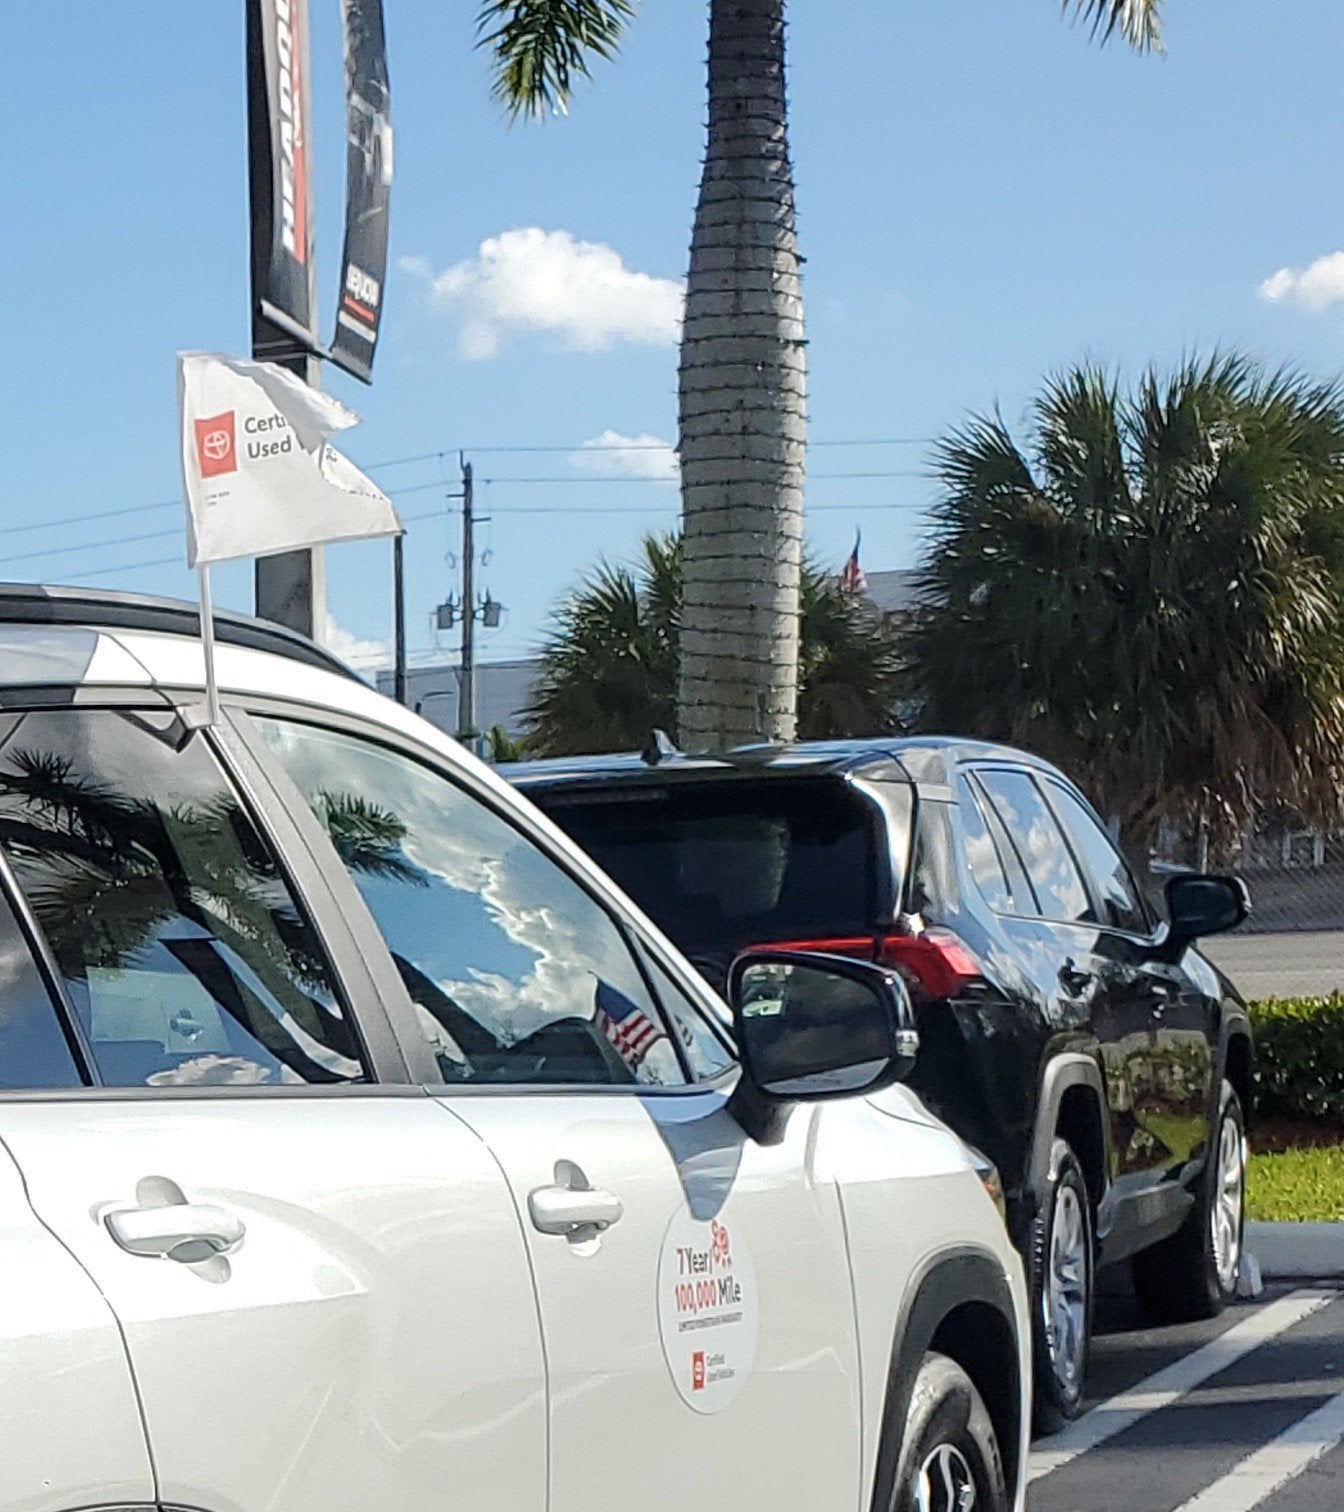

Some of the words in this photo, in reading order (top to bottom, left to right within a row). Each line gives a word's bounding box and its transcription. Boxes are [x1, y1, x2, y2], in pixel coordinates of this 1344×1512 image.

[247, 435, 292, 459] Used
[675, 1248, 685, 1275] 7
[675, 1279, 717, 1314] 100,000
[717, 1275, 742, 1306] Mile
